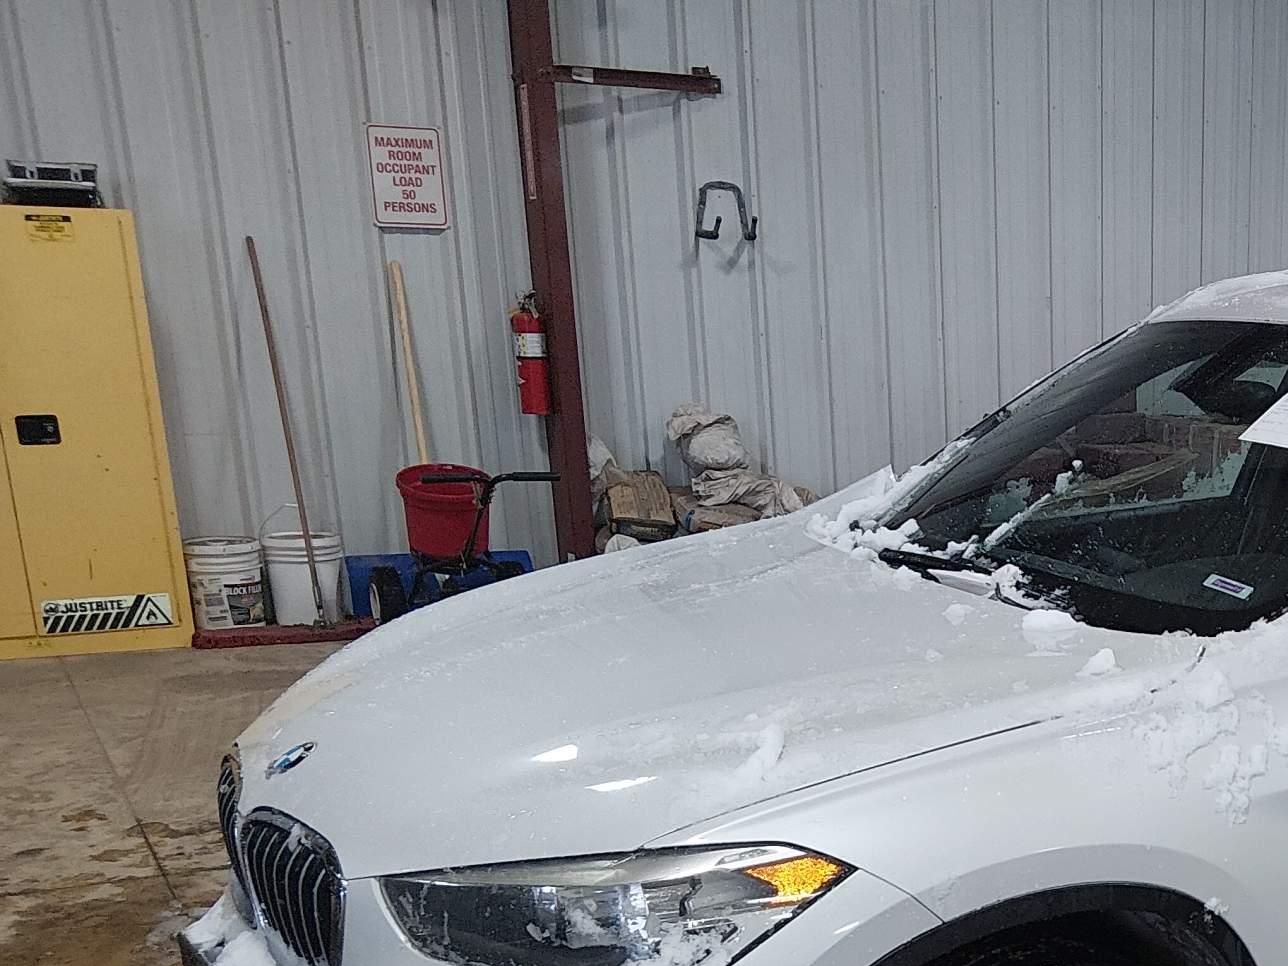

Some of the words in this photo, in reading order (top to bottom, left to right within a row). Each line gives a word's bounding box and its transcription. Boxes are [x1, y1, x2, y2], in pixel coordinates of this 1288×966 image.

[374, 136, 434, 150] MAXIMUM
[388, 150, 423, 162] ROOM
[376, 162, 436, 175] OCCUPANT
[392, 176, 423, 188] LOAD
[401, 190, 416, 200] 50
[383, 201, 437, 214] PERSONS
[224, 586, 247, 596] BLOCK
[60, 600, 125, 614] JUSTRITE
